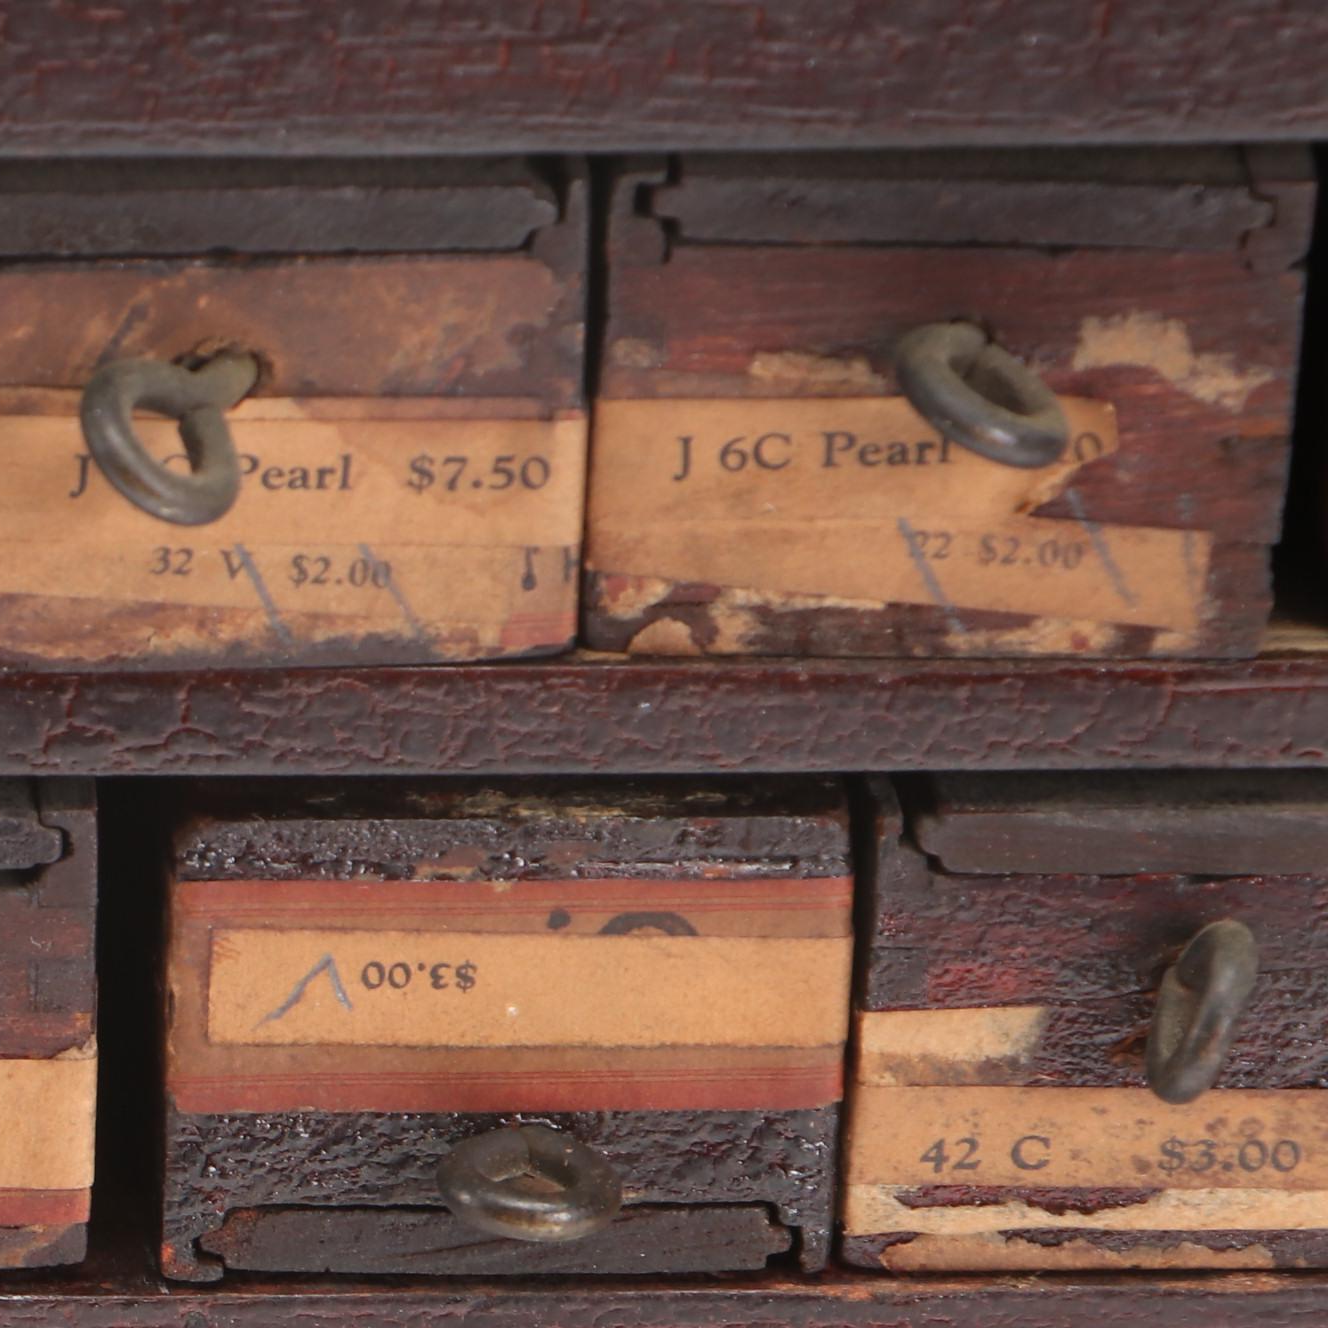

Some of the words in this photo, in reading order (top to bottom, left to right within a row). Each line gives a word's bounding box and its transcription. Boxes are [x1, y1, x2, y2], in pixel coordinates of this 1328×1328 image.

[407, 454, 551, 494] $7.50
[673, 436, 694, 481] J
[719, 431, 791, 472] 6C
[821, 433, 951, 467] Pearl
[150, 546, 194, 576] 32
[220, 550, 252, 580] V
[290, 554, 392, 589] $2.00
[978, 533, 1084, 570] $2.00
[360, 959, 478, 991] $3.00
[919, 1136, 982, 1173] 42
[1010, 1135, 1052, 1171] C
[1157, 1135, 1302, 1176] $3.00
